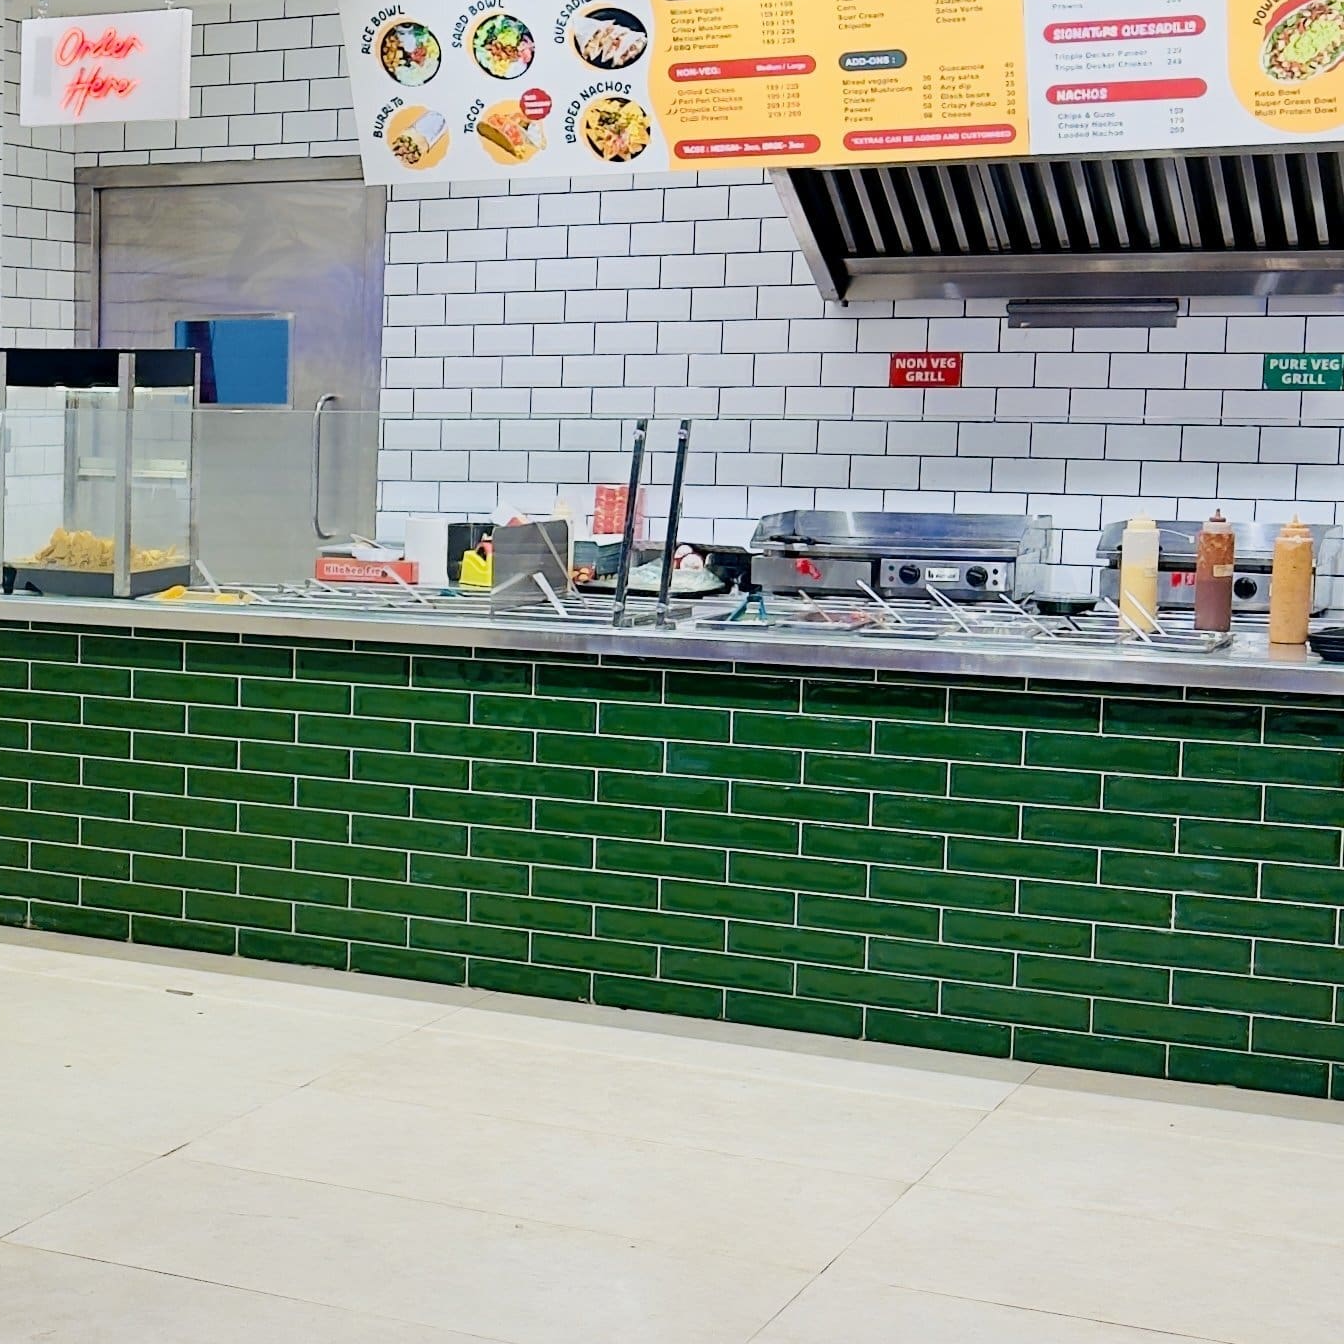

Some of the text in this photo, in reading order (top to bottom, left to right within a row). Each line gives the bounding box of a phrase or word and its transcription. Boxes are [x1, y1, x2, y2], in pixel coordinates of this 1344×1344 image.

[371, 4, 405, 27] BOWL
[56, 27, 143, 66] Order
[62, 66, 140, 117] Here
[579, 80, 632, 101] NACHOS
[1056, 88, 1108, 101] NACHOS
[896, 357, 957, 370] NON VEG
[1270, 357, 1341, 371] PURE VEG
[905, 370, 945, 383] GRILL
[1282, 372, 1326, 385] GRILL
